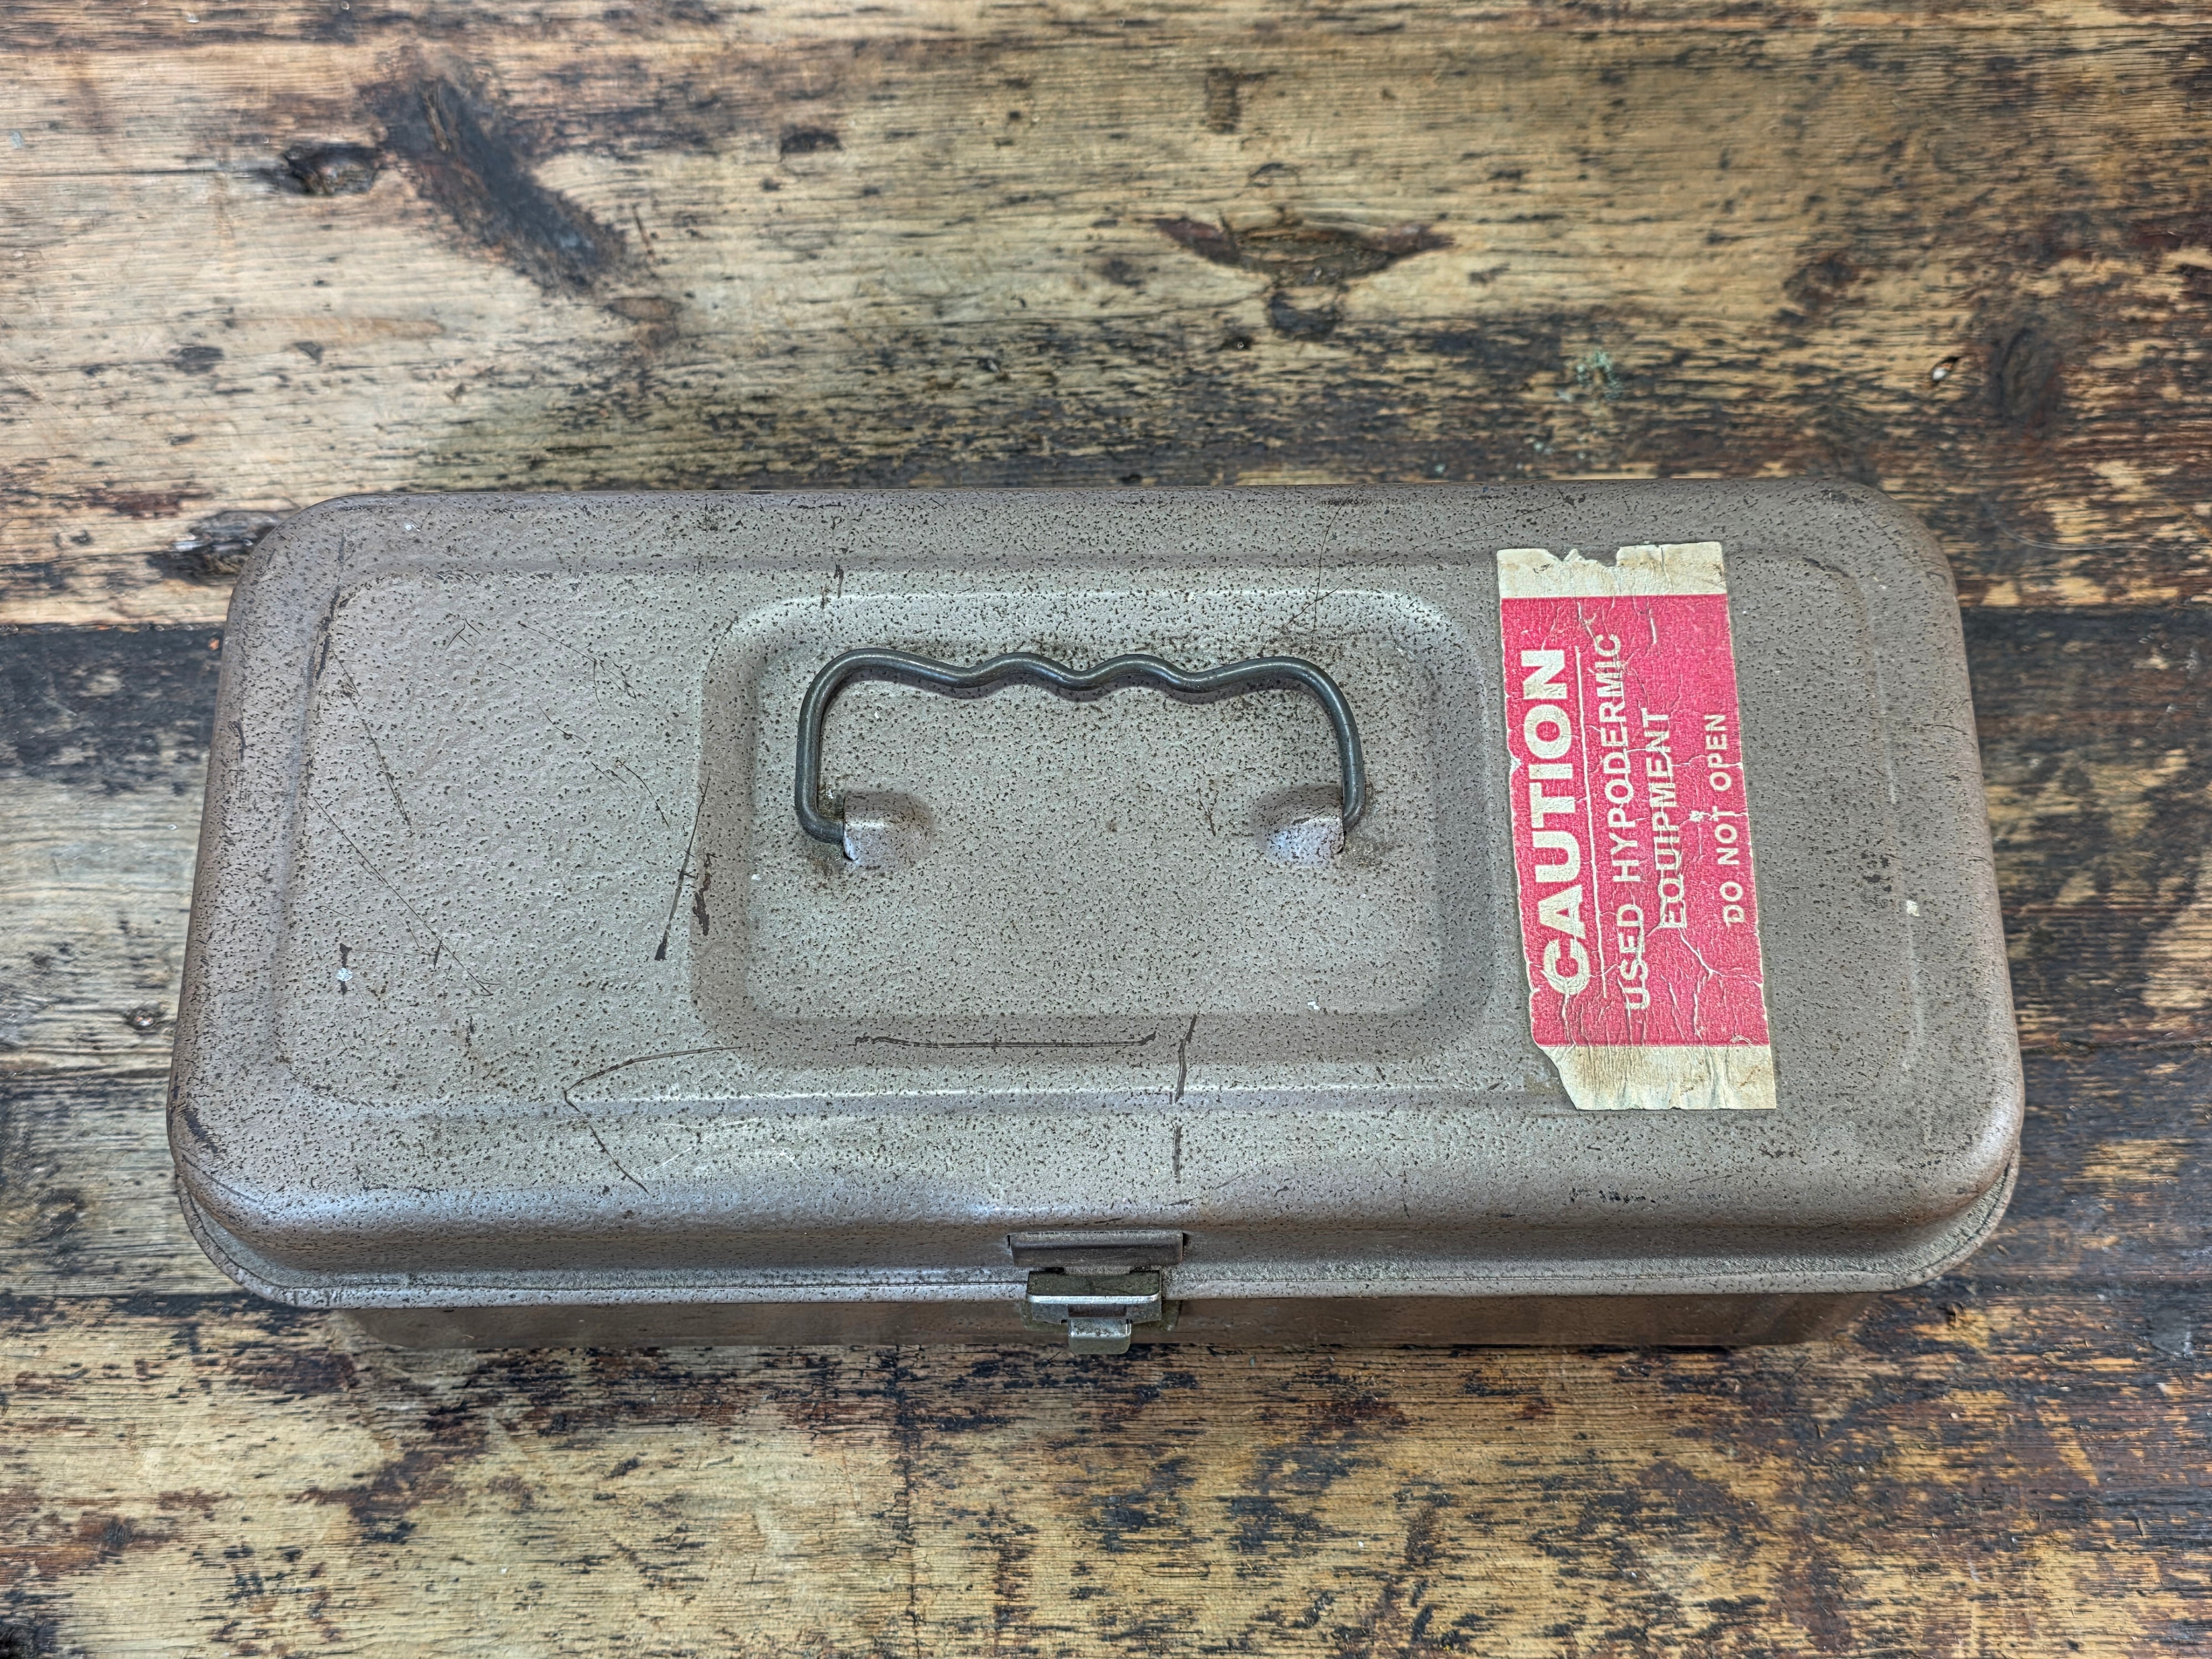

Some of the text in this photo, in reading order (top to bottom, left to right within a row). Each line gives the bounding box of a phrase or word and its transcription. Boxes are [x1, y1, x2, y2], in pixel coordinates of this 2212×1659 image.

[1521, 650, 1589, 995] CAUTION
[1595, 634, 1650, 1009] USED HYPODERMIC
[1641, 707, 1686, 928] EQUIPMENT
[1704, 714, 1744, 924] DO NOT OPEN
